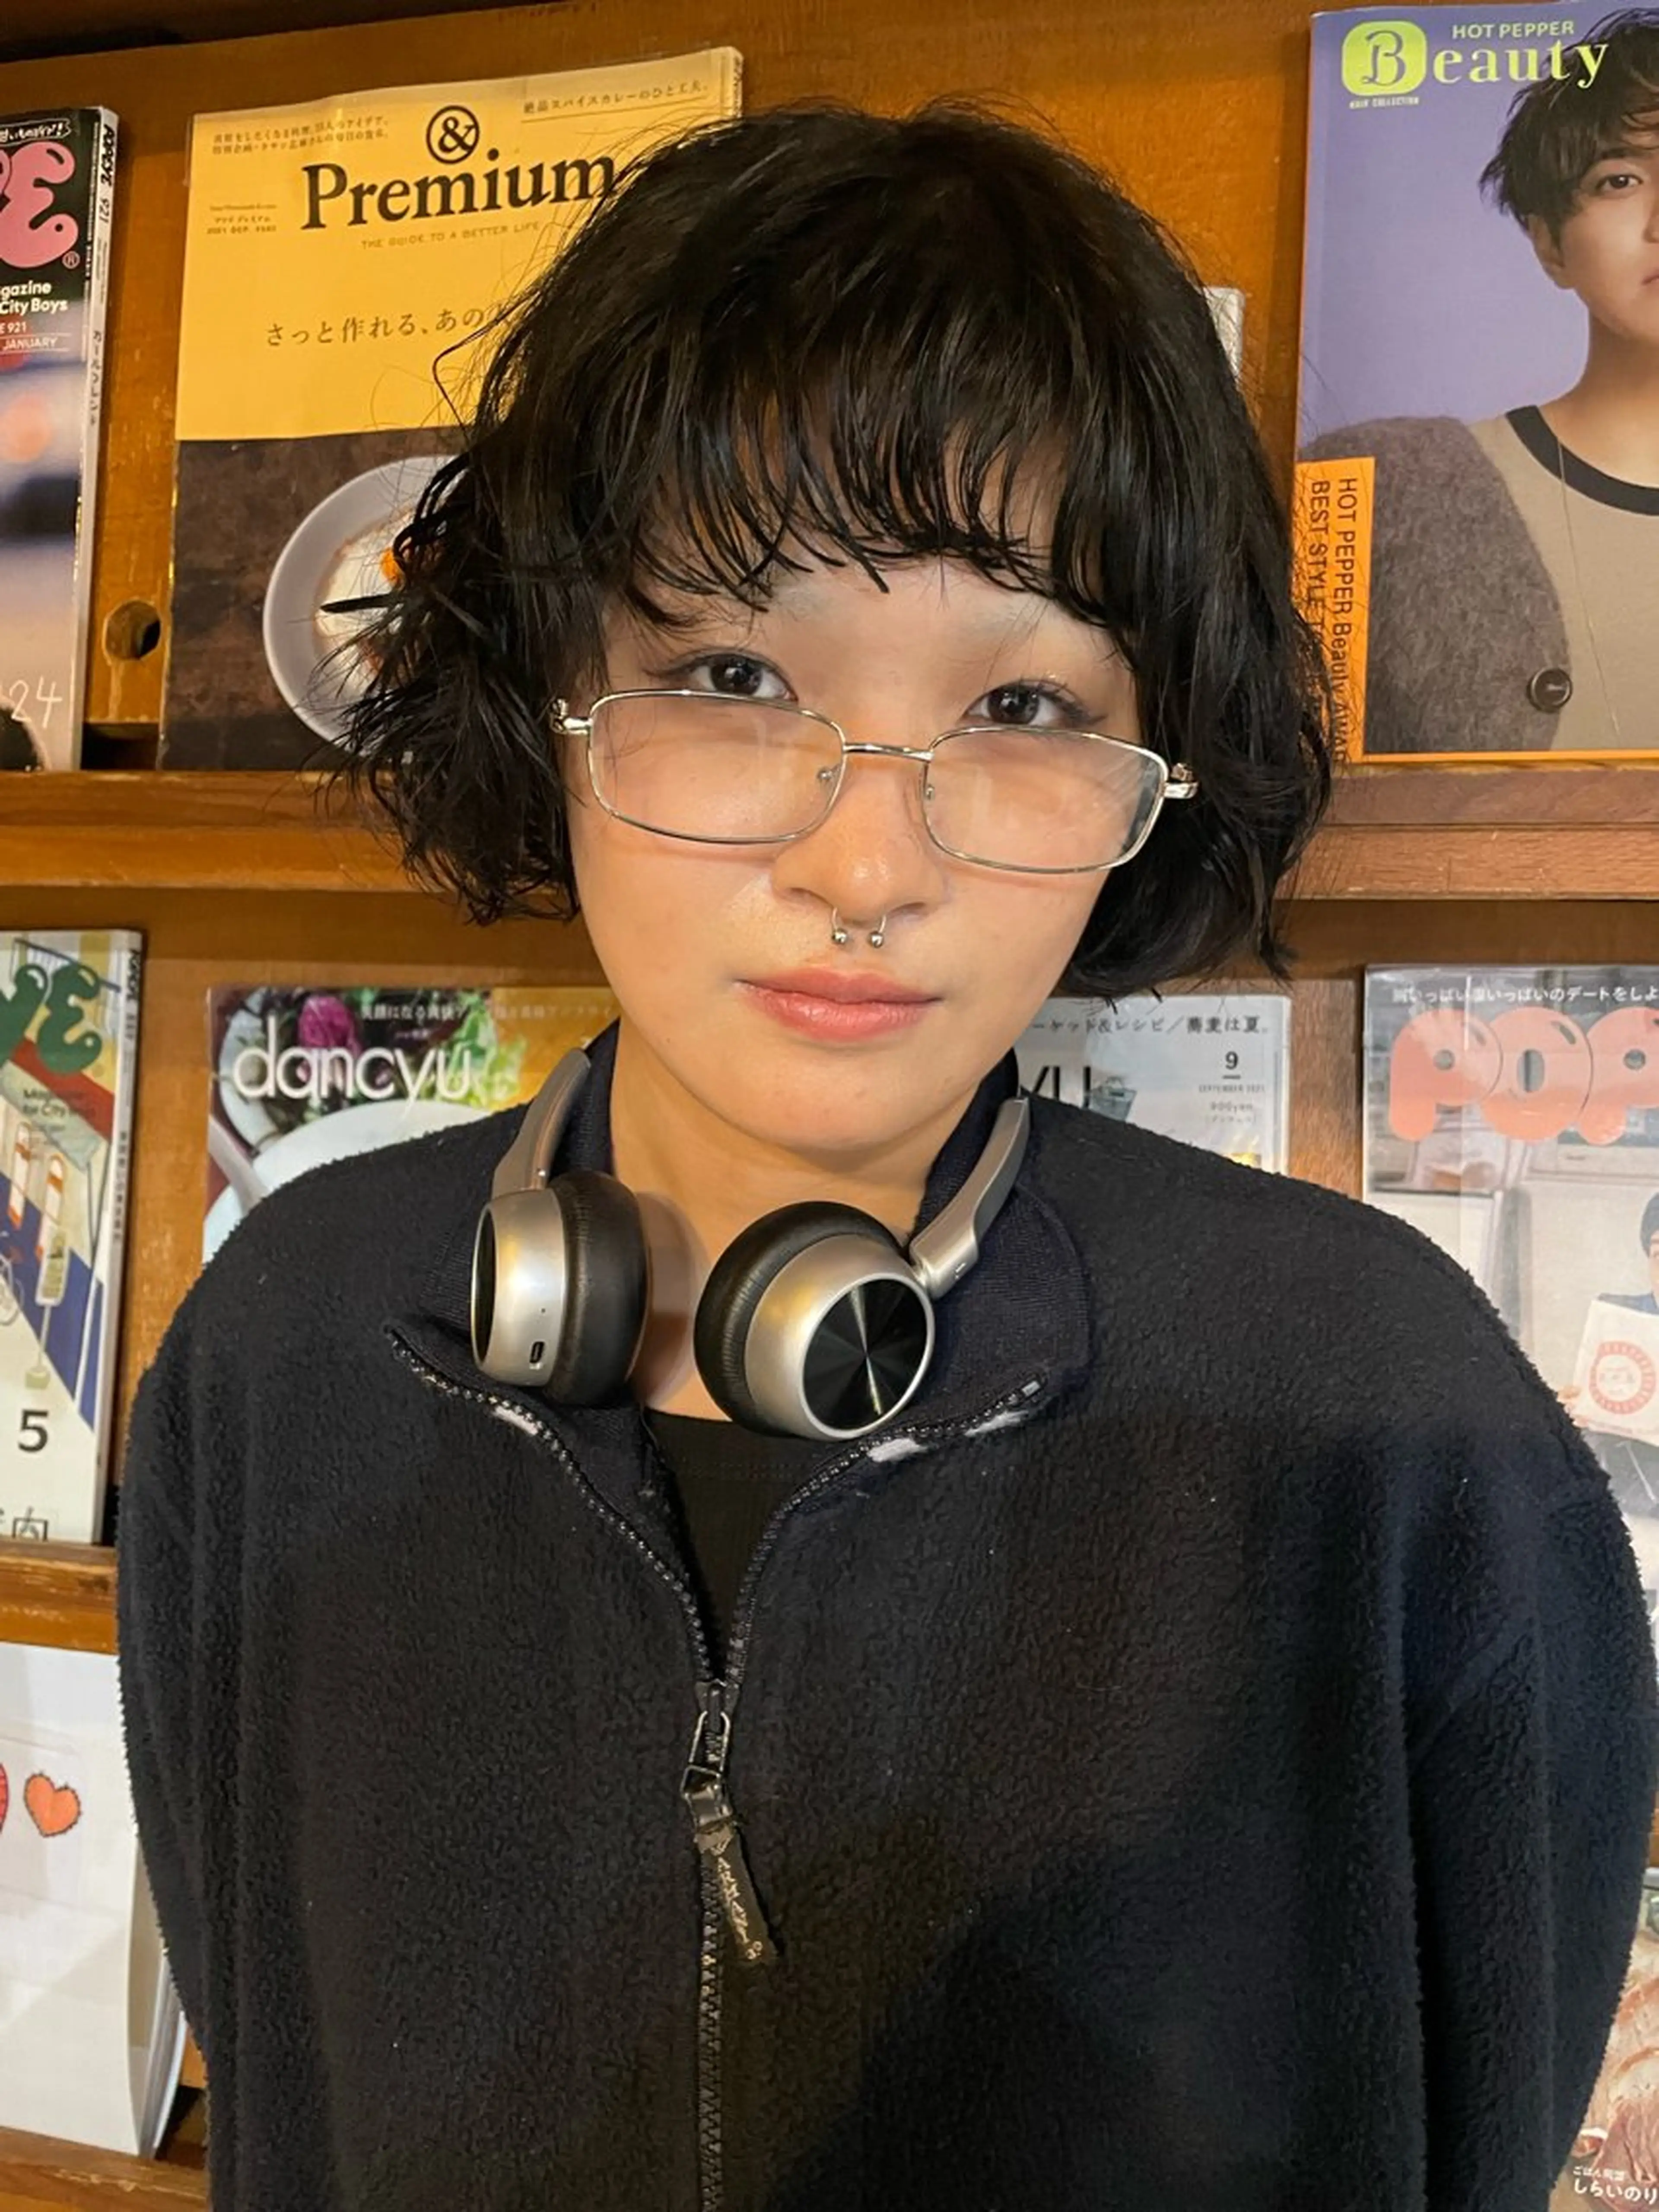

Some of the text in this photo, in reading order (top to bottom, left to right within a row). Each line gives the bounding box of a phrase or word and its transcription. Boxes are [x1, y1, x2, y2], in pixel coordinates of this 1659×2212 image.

[1452, 20, 1574, 39] HOT PEPPER
[1361, 29, 1609, 89] Beauty
[301, 148, 617, 230] Premium
[361, 238, 382, 250] THE
[388, 235, 423, 246] GUIDE
[430, 232, 445, 241] TO
[461, 226, 508, 239] BETTER
[513, 221, 539, 233] LIFE
[0, 297, 68, 316] City Boys
[7, 321, 27, 334] 921
[3, 337, 58, 350] JANUARY
[1309, 480, 1330, 534] BEST
[1337, 478, 1357, 522] HOT
[1307, 543, 1328, 608] STYLE
[1333, 531, 1355, 615] PEPPER
[233, 1014, 472, 1117] dancyu
[1225, 1051, 1239, 1070] 9
[17, 1408, 49, 1453] 5
